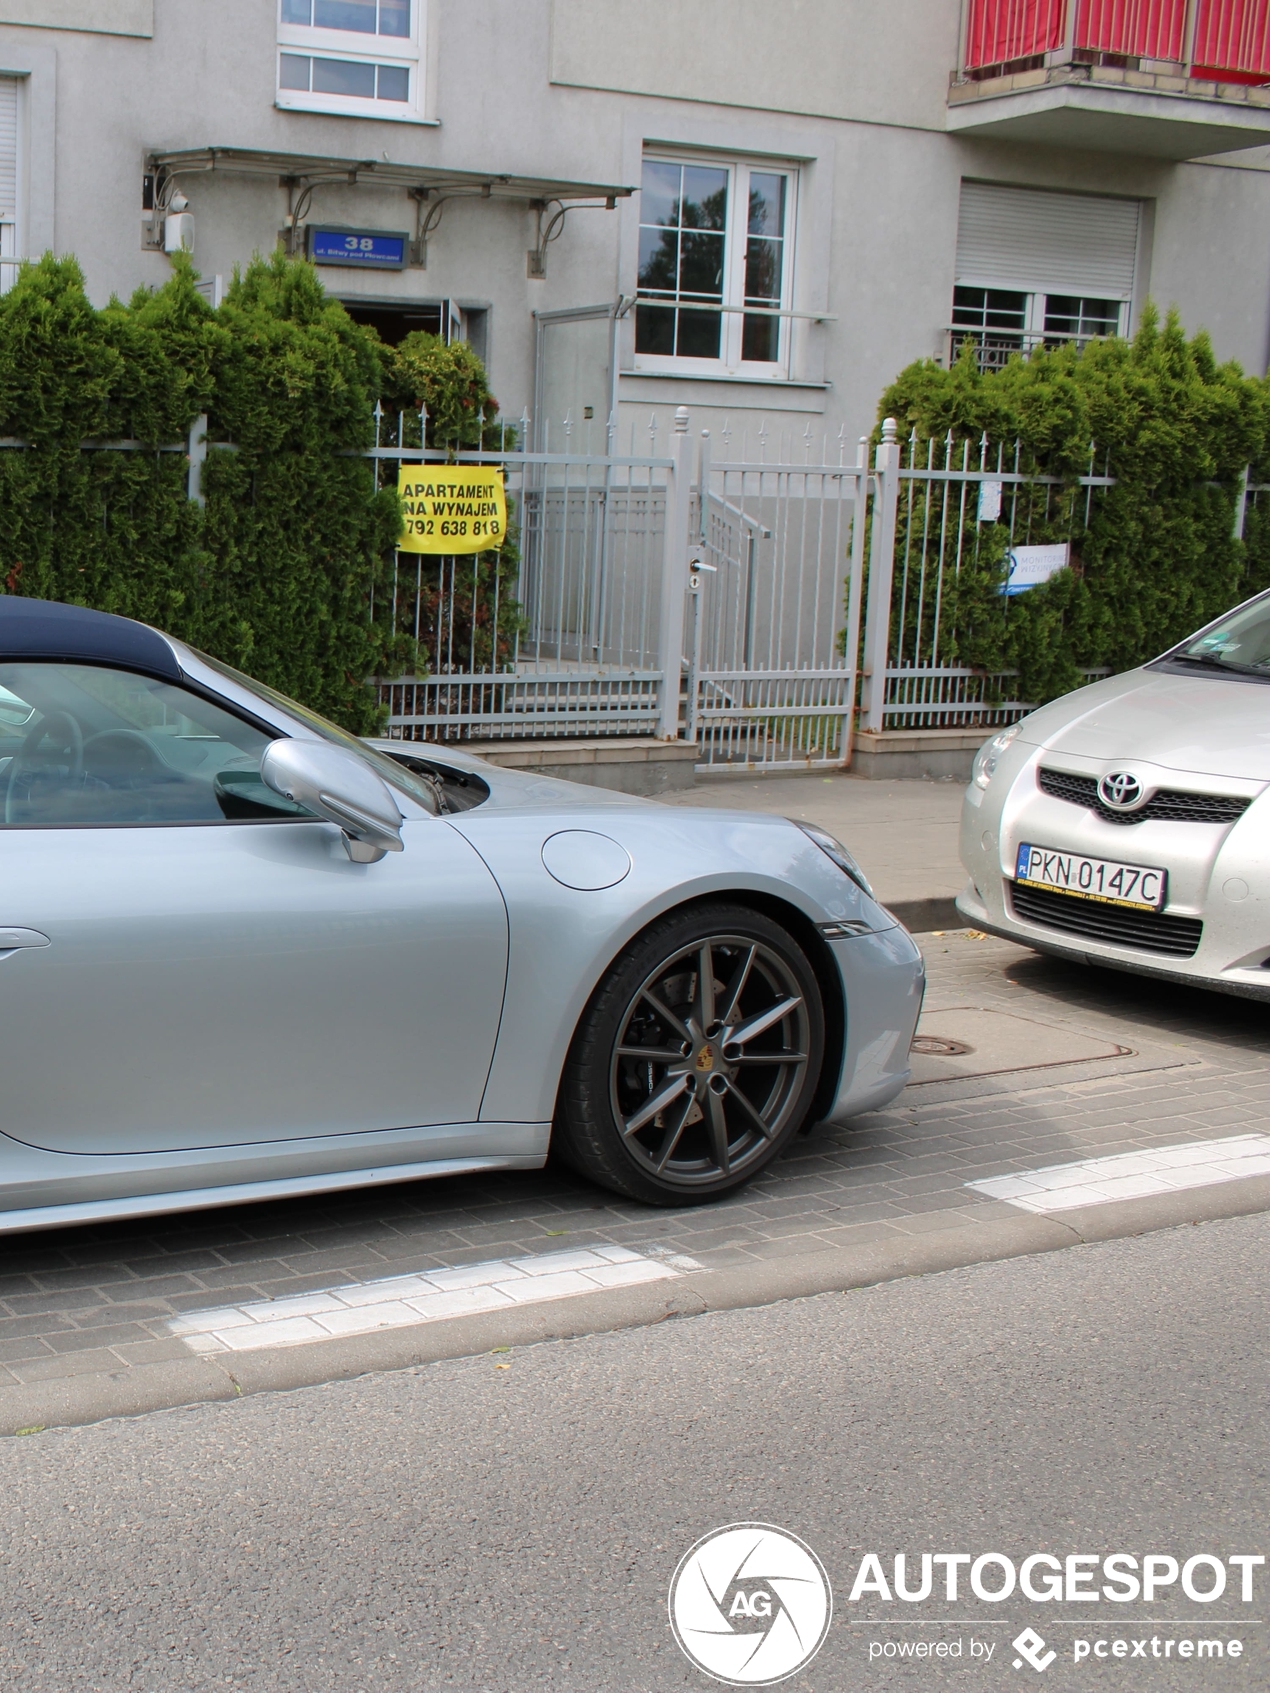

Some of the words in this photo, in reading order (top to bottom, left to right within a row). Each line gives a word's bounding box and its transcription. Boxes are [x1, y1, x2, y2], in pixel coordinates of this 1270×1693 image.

[344, 236, 373, 251] 38
[327, 248, 348, 258] Bitwy
[349, 250, 363, 258] pod
[403, 483, 495, 499] APARTAMENT
[404, 501, 427, 516] NA
[432, 502, 498, 517] WYNAJEM
[407, 519, 434, 535] 792
[440, 520, 467, 536] 638
[473, 520, 500, 536] 818
[1018, 864, 1027, 874] PL
[1028, 850, 1071, 886] PKN
[1078, 861, 1159, 902] 0147C
